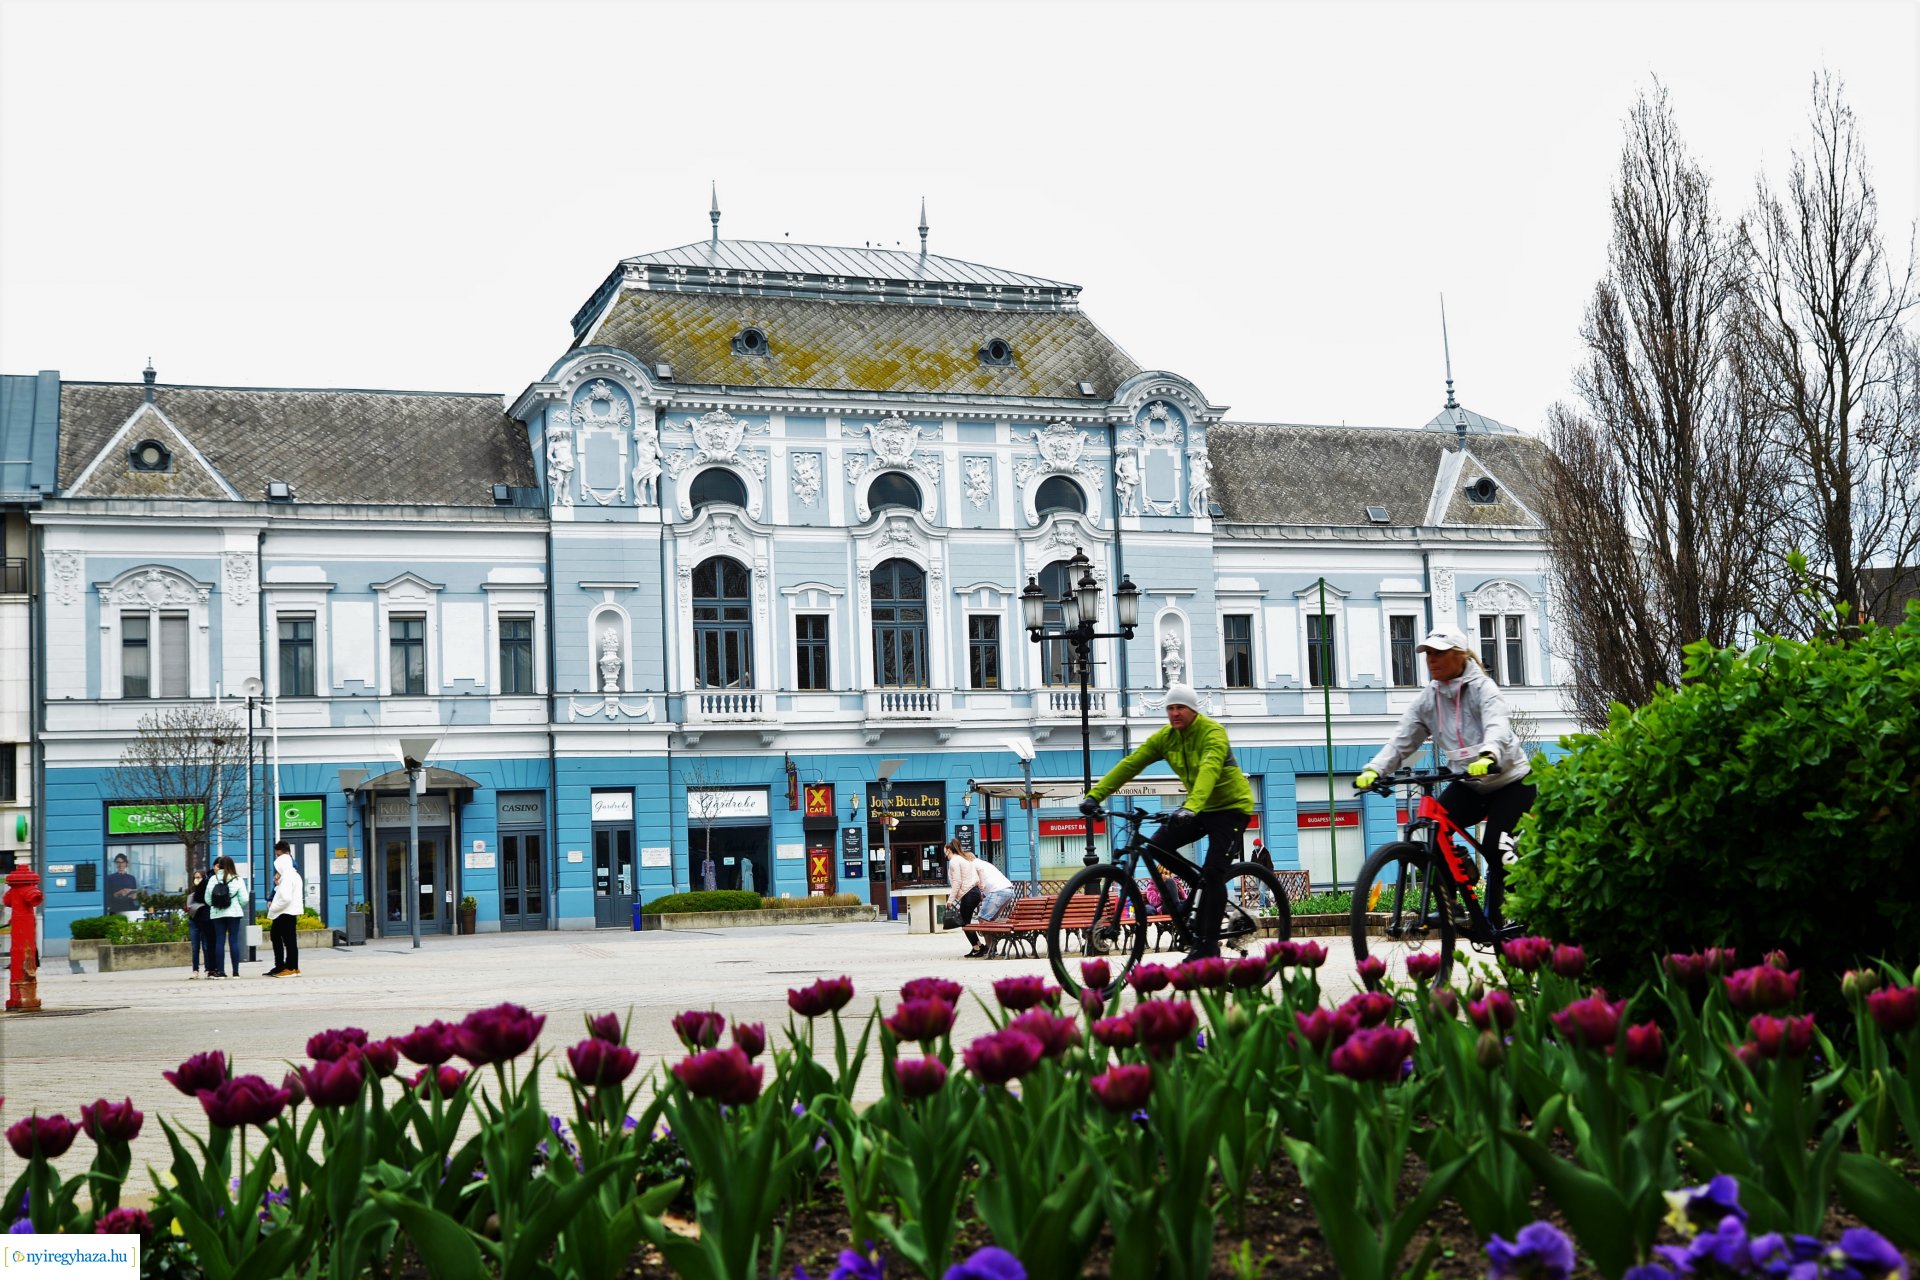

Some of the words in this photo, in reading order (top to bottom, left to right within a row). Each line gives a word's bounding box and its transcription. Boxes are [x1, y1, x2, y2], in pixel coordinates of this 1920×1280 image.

[810, 789, 826, 806] X
[895, 795, 920, 807] BULL
[921, 794, 940, 806] PUB
[501, 804, 539, 812] CASINO
[812, 856, 827, 876] X
